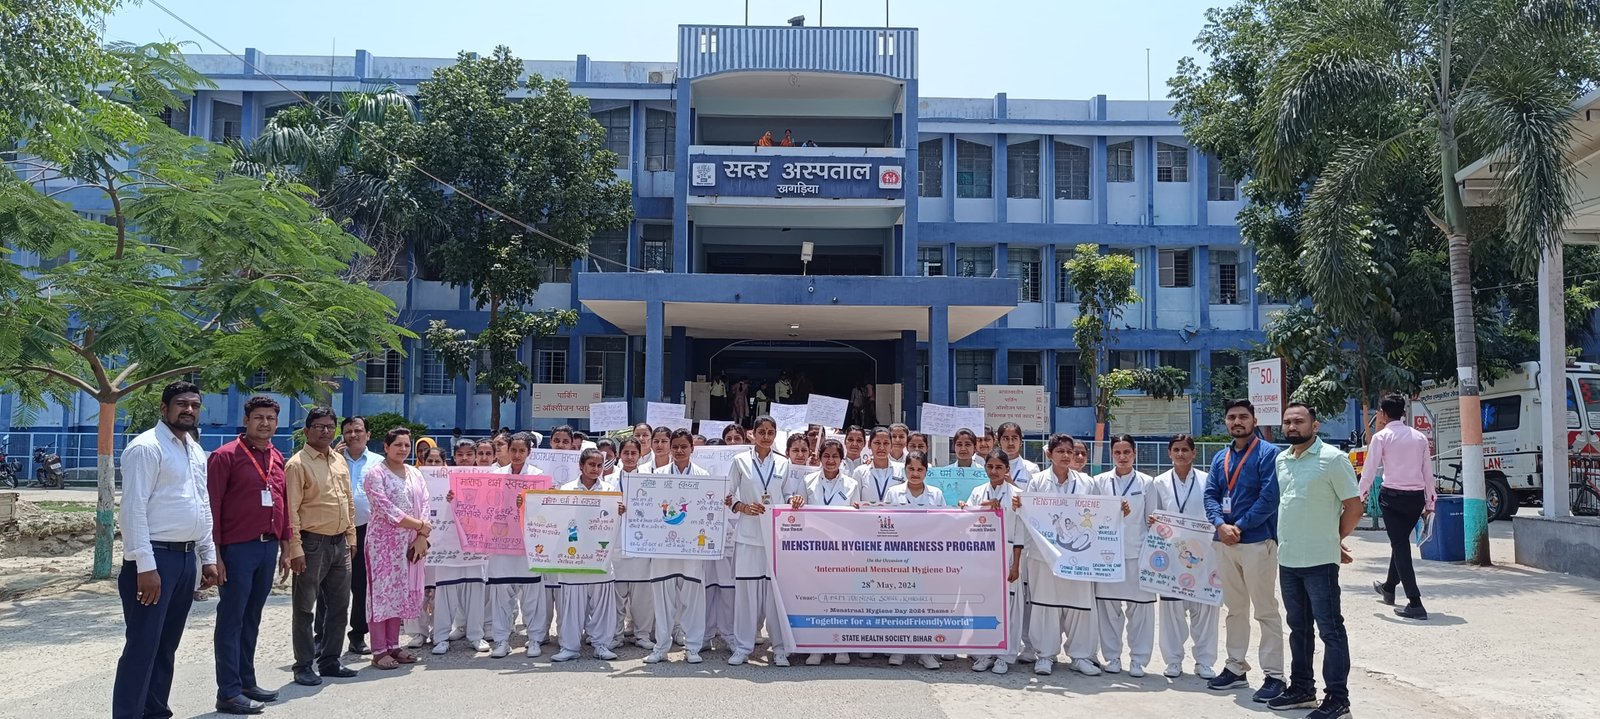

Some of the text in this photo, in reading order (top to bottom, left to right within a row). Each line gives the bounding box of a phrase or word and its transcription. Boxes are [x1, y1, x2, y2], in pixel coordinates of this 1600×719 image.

[723, 161, 872, 180] सदर अस्पताल
[777, 182, 819, 196] खगड़िया
[1260, 368, 1272, 384] 50
[1033, 498, 1069, 507] MENSTRUAL
[782, 540, 996, 552] MENSTRUAL HYGIENE AWARENESS PROGRAM
[870, 566, 910, 574] Menstrual
[912, 566, 944, 575] Hygiene
[876, 582, 896, 590] May,
[850, 616, 864, 625] for
[842, 634, 932, 643] STATE HEALTH SOCIETY, BIHAR
